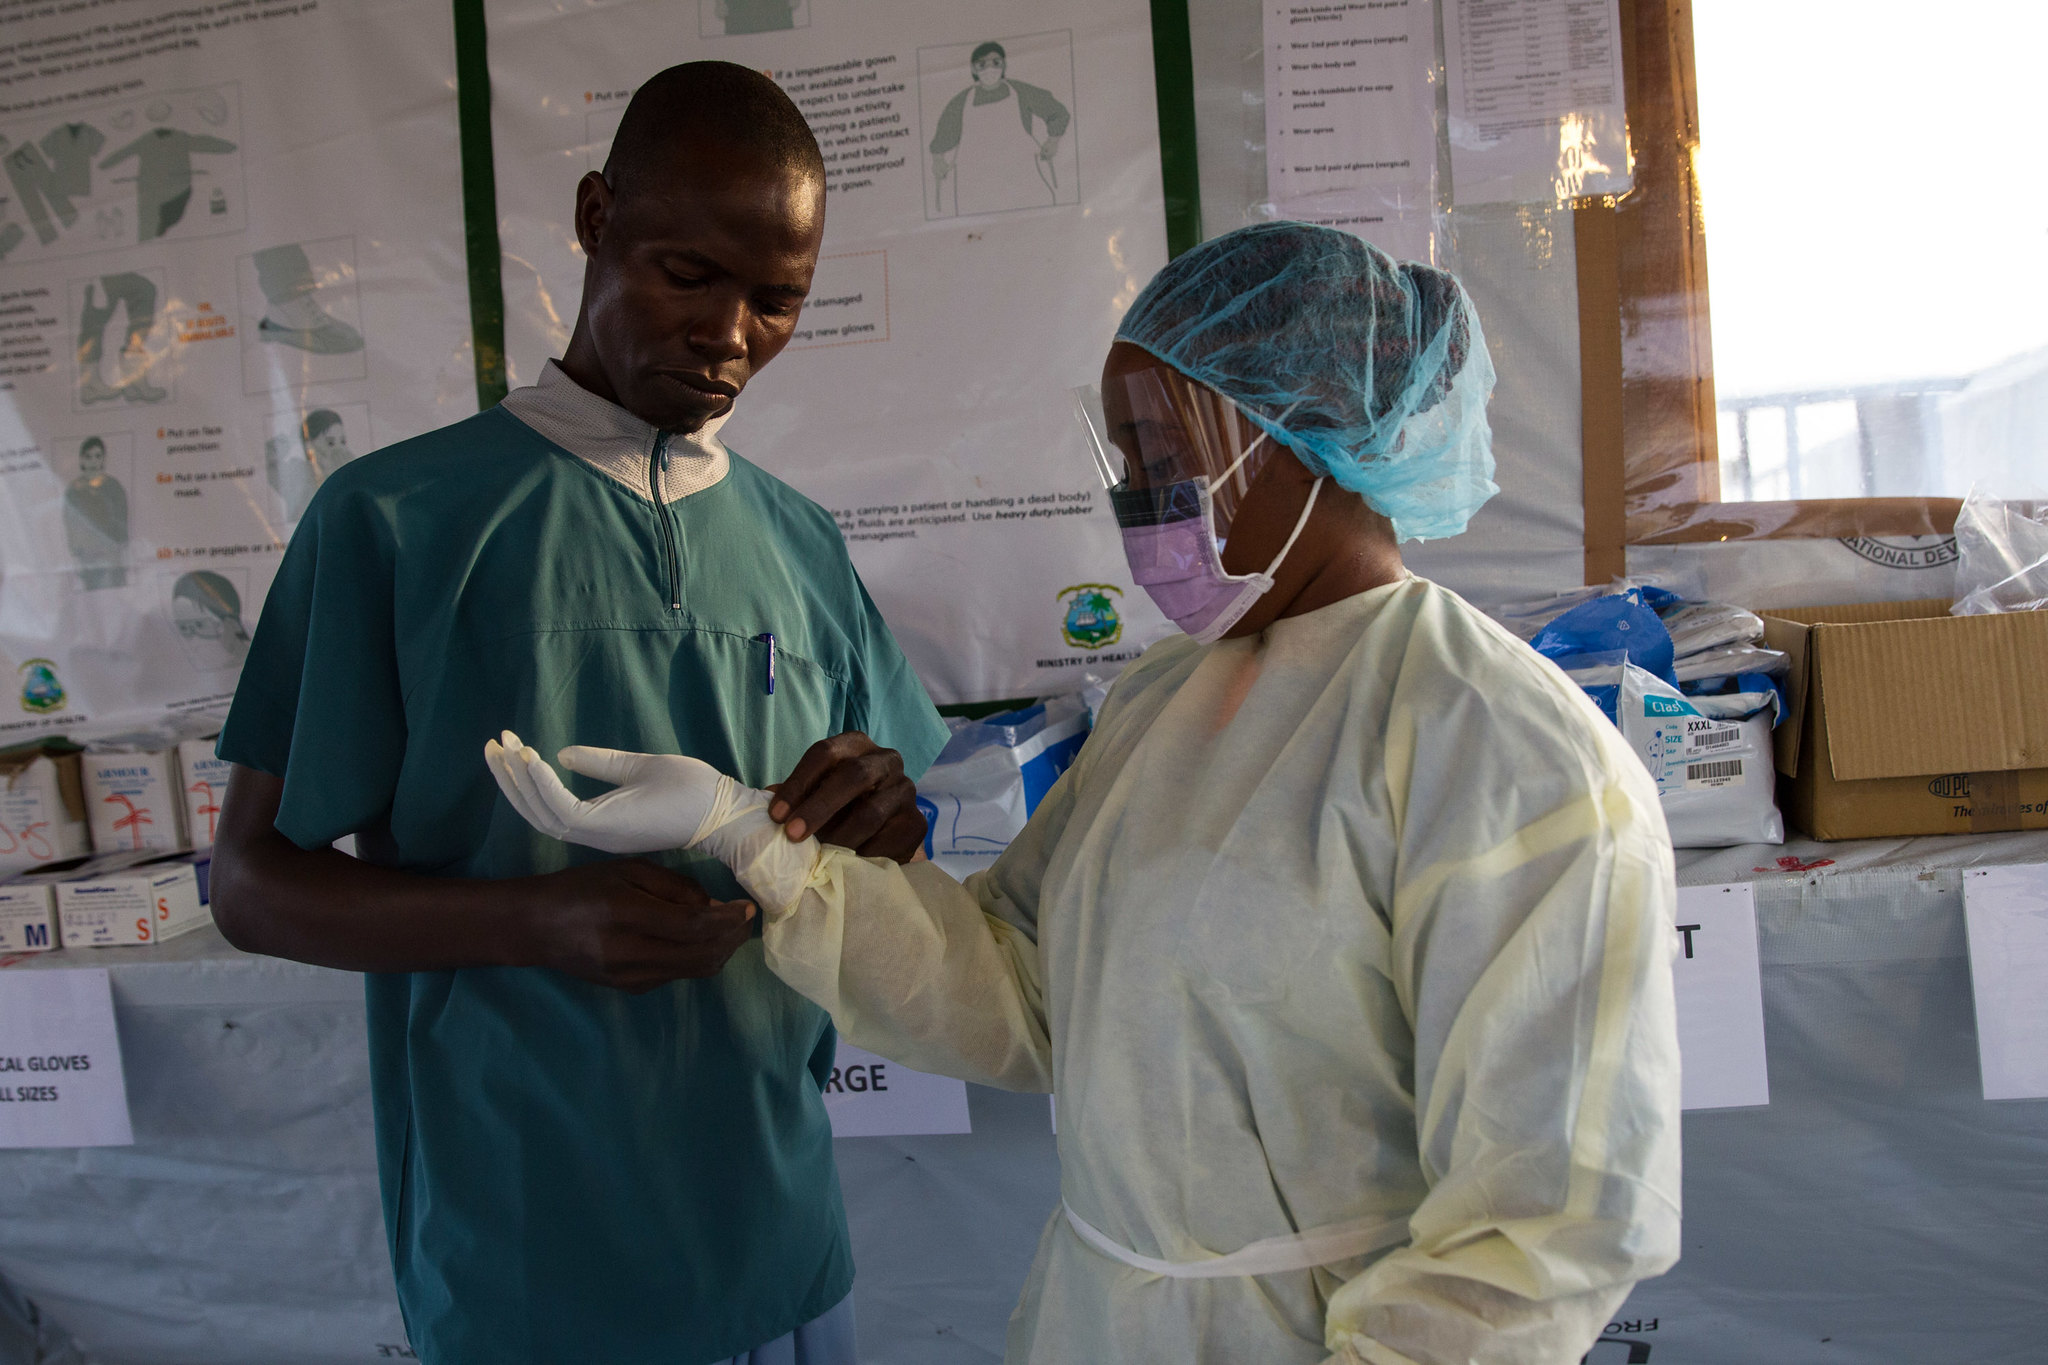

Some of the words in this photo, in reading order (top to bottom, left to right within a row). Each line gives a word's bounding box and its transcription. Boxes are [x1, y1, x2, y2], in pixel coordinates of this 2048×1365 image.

[1290, 42, 1309, 50] Wear
[1326, 41, 1340, 49] pair
[1350, 38, 1373, 47] gloves
[795, 59, 863, 77] impermeable
[865, 55, 897, 68] gown
[1291, 63, 1310, 71] Wear
[1311, 61, 1323, 69] the
[1324, 60, 1342, 69] body
[787, 83, 806, 93] not
[808, 75, 854, 91] available
[857, 71, 877, 84] and
[595, 90, 613, 101] Put
[799, 95, 834, 107] expect
[837, 91, 849, 100] to
[851, 83, 905, 99] undertake
[1292, 89, 1311, 97] Make
[1318, 86, 1356, 95] thumbhole
[854, 100, 892, 115] activity
[1293, 100, 1326, 110] provided
[849, 121, 856, 130] a
[858, 113, 901, 130] patient)
[823, 139, 834, 148] in
[836, 133, 868, 147] which
[870, 128, 910, 142] contact
[1293, 127, 1311, 135] Wear
[1313, 126, 1335, 135] apron
[840, 149, 861, 160] and
[863, 145, 890, 158] body
[845, 157, 905, 174] waterproof
[1294, 165, 1313, 174] Wear
[1314, 164, 1327, 172] 3rd
[1327, 164, 1342, 173] pair
[1352, 161, 1375, 171] gloves
[813, 292, 864, 308] damaged
[815, 326, 839, 337] new
[841, 323, 875, 336] gloves
[174, 470, 191, 483] Put
[219, 466, 255, 480] medical
[856, 504, 899, 518] carrying
[901, 504, 908, 513] a
[910, 501, 948, 514] patient
[950, 501, 962, 510] or
[965, 495, 1015, 509] handling
[1017, 497, 1025, 505] a
[1027, 492, 1056, 505] dead
[1058, 491, 1092, 504] body)
[858, 518, 885, 529] fluids
[888, 519, 904, 528] are
[972, 511, 992, 521] Use
[995, 508, 1028, 521] heavy
[1029, 504, 1093, 519] duty/rubber
[209, 545, 249, 557] goggles
[1036, 656, 1083, 669] MINISTRY
[1086, 655, 1099, 665] OF
[1687, 719, 1712, 733] XXXL
[1665, 735, 1682, 743] SIZE
[157, 896, 170, 922] S
[24, 923, 49, 947] M
[136, 917, 151, 942] S
[1675, 923, 1701, 959] T
[27, 1055, 91, 1072] GLOVES
[825, 1064, 889, 1094] RGE
[17, 1085, 59, 1102] SIZES
